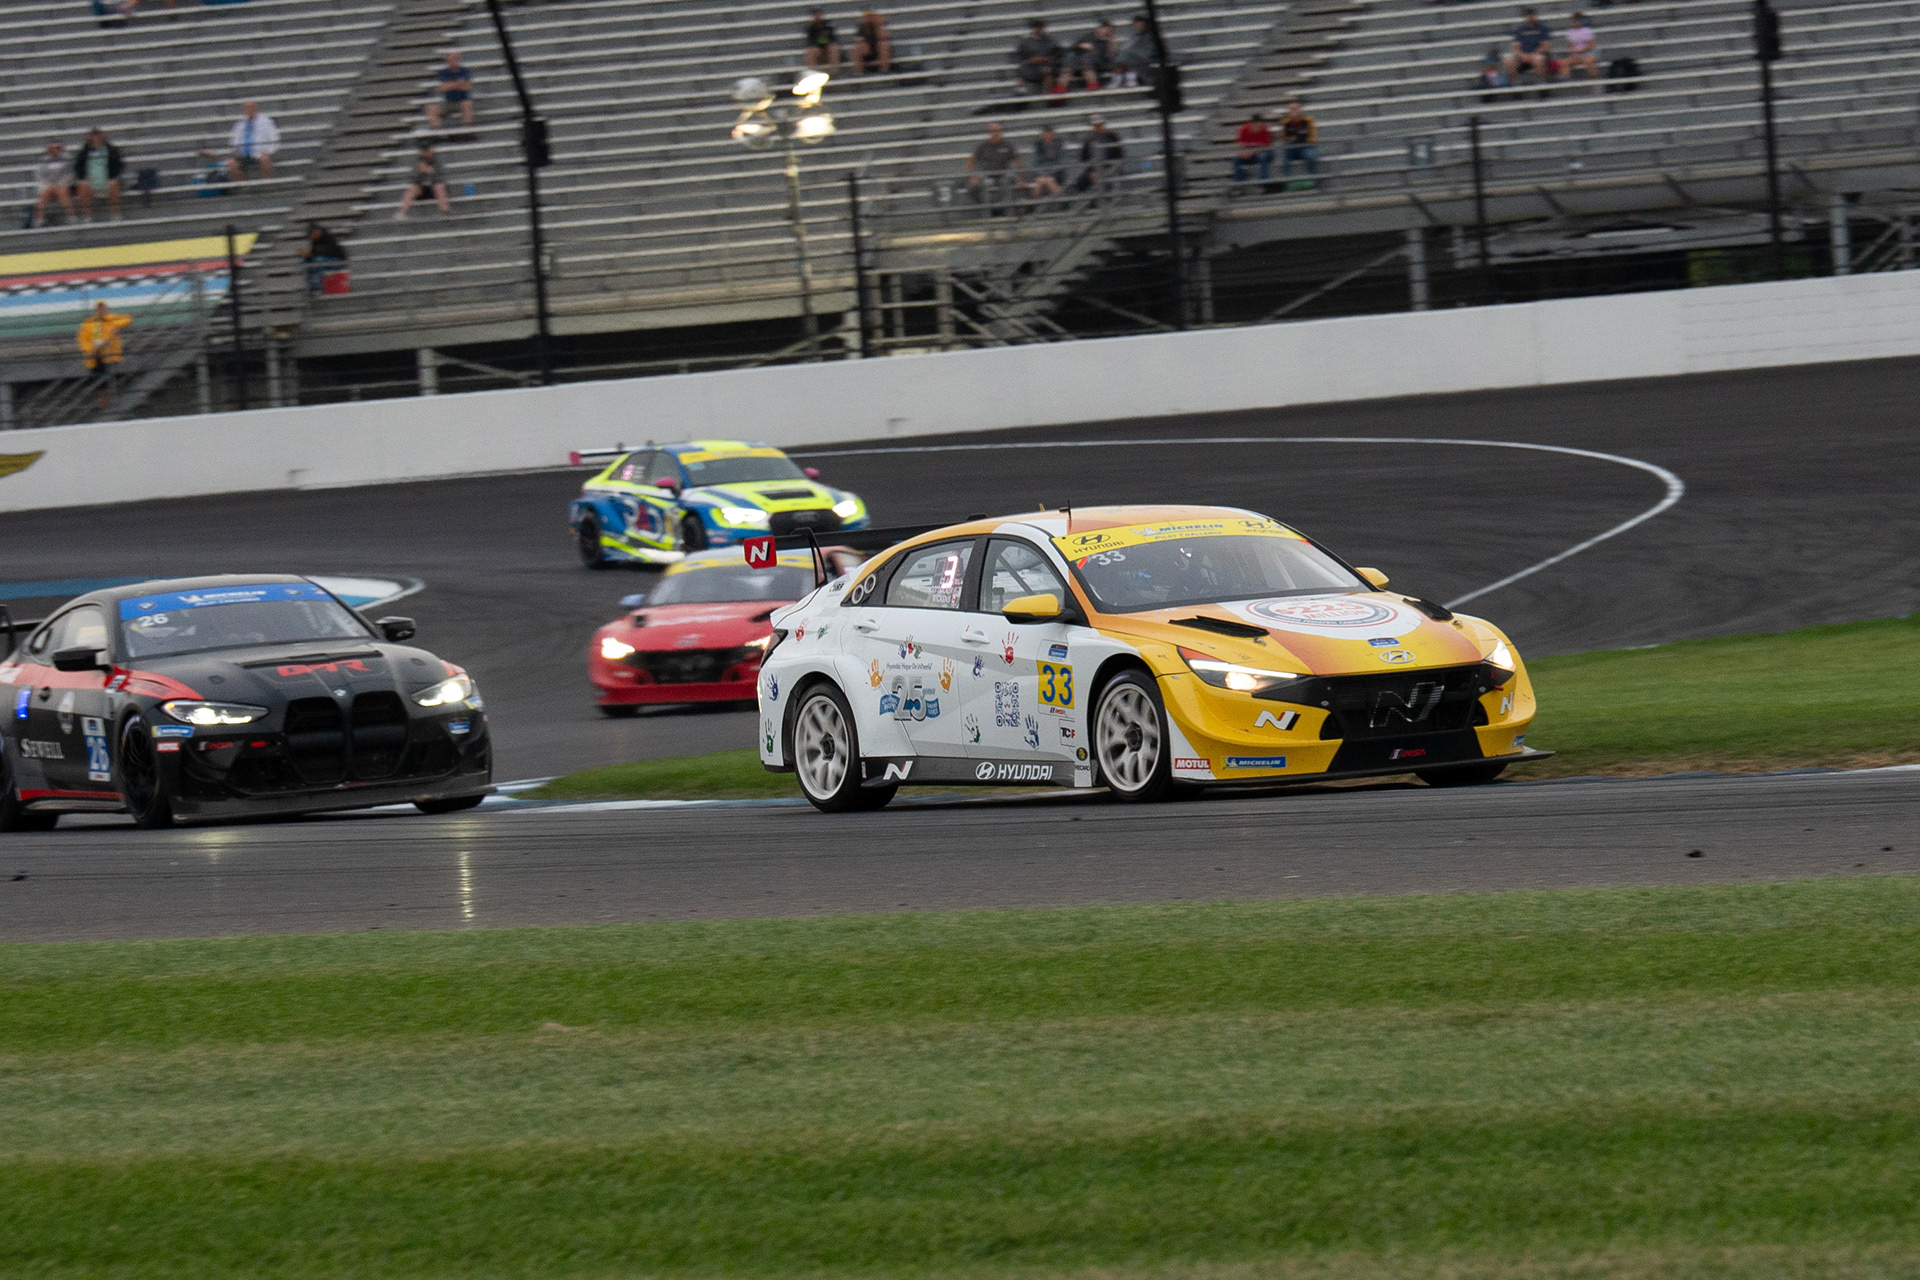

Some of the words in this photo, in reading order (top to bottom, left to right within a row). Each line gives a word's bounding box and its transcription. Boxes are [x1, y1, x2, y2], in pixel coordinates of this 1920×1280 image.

[1159, 523, 1223, 532] MICHELIN
[749, 540, 769, 563] N
[1073, 540, 1125, 554] HYUNDAI
[1091, 550, 1126, 565] 33
[941, 555, 959, 589] 3
[138, 613, 169, 628] 26
[1042, 664, 1073, 706] 33
[892, 675, 927, 722] 25
[1253, 710, 1301, 731] N
[85, 736, 111, 772] 26
[1176, 759, 1210, 769] MOTUL
[882, 760, 913, 780] N
[997, 764, 1053, 780] HYUNDAI
